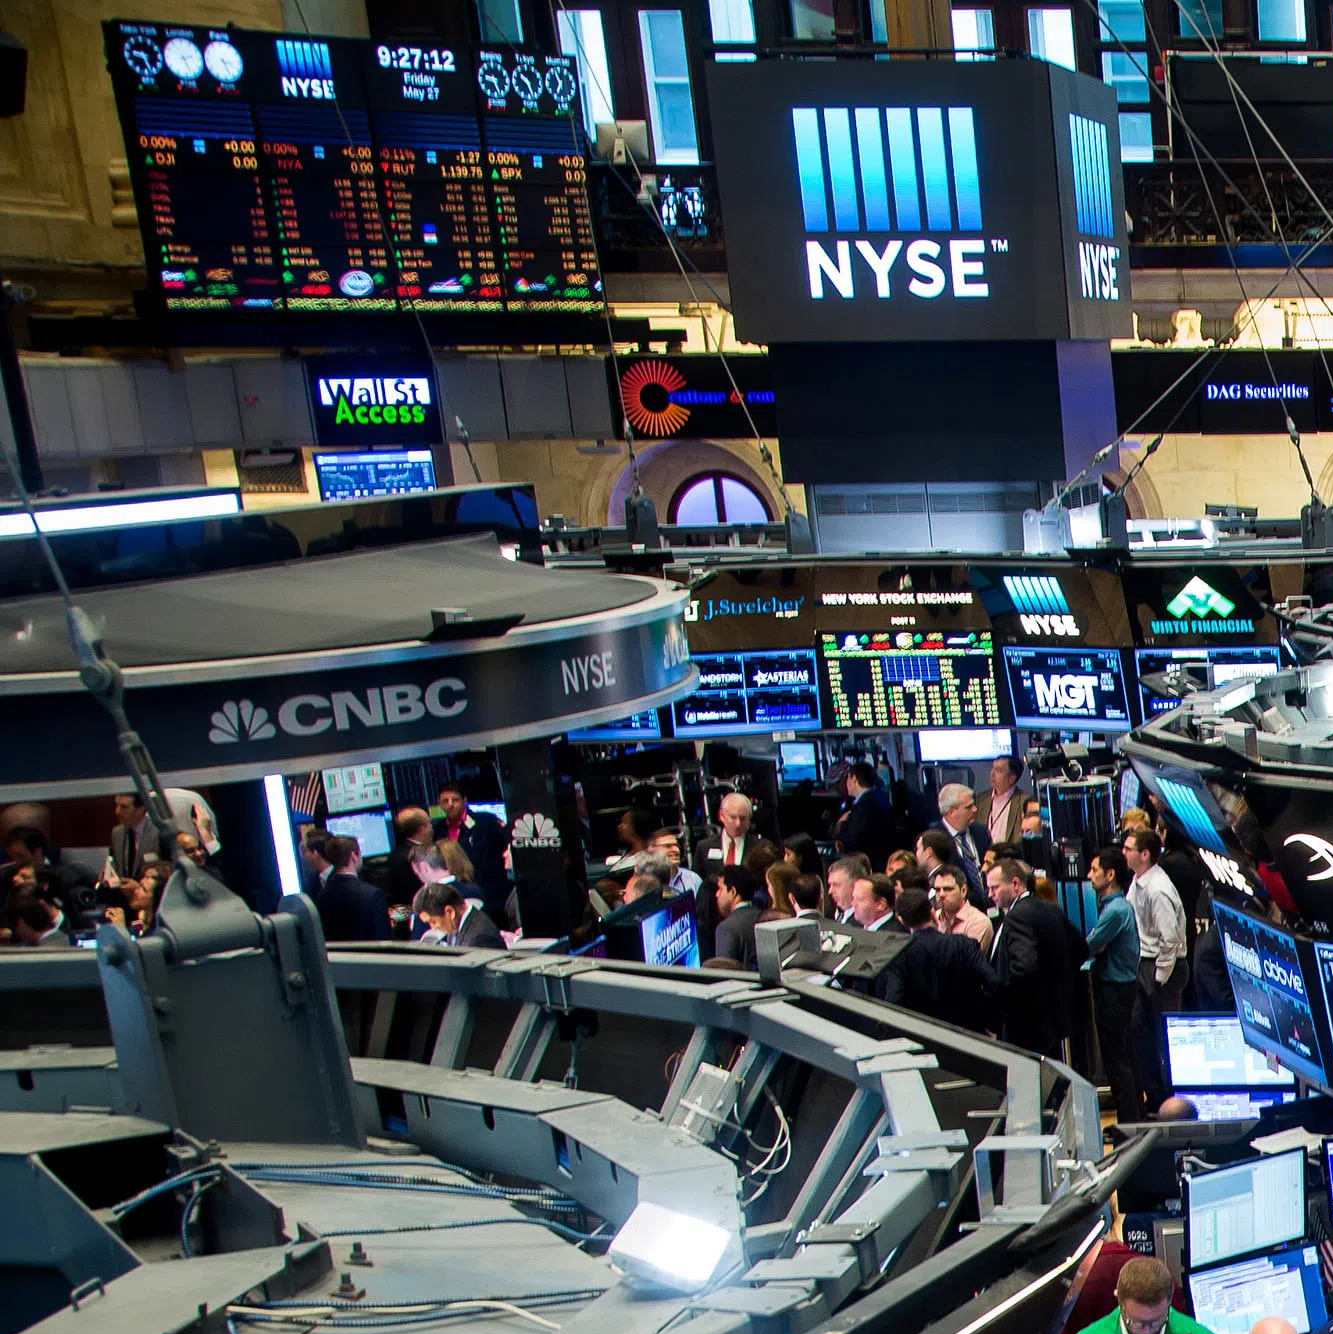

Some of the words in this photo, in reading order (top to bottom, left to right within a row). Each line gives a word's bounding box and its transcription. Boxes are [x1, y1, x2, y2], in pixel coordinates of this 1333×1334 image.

[377, 46, 456, 72] 9:27:12
[281, 77, 336, 99] NYSE
[403, 72, 435, 86] Friday
[403, 86, 425, 101] May
[805, 240, 990, 299] NYSE
[1078, 241, 1120, 301] NYSE
[1207, 384, 1240, 399] DAG
[1245, 384, 1309, 399] Securities
[336, 394, 425, 424] Access
[822, 593, 846, 605] NEW
[849, 593, 878, 604] YORK
[880, 592, 915, 604] STOCK
[917, 592, 973, 604] EXCHANGE
[1019, 614, 1080, 637] NYSE
[1151, 619, 1189, 635] VIRTU
[1192, 618, 1255, 634] FINANCIAL
[561, 650, 617, 696] NYSE
[1033, 673, 1099, 710] MGT
[279, 677, 469, 738] CNBC
